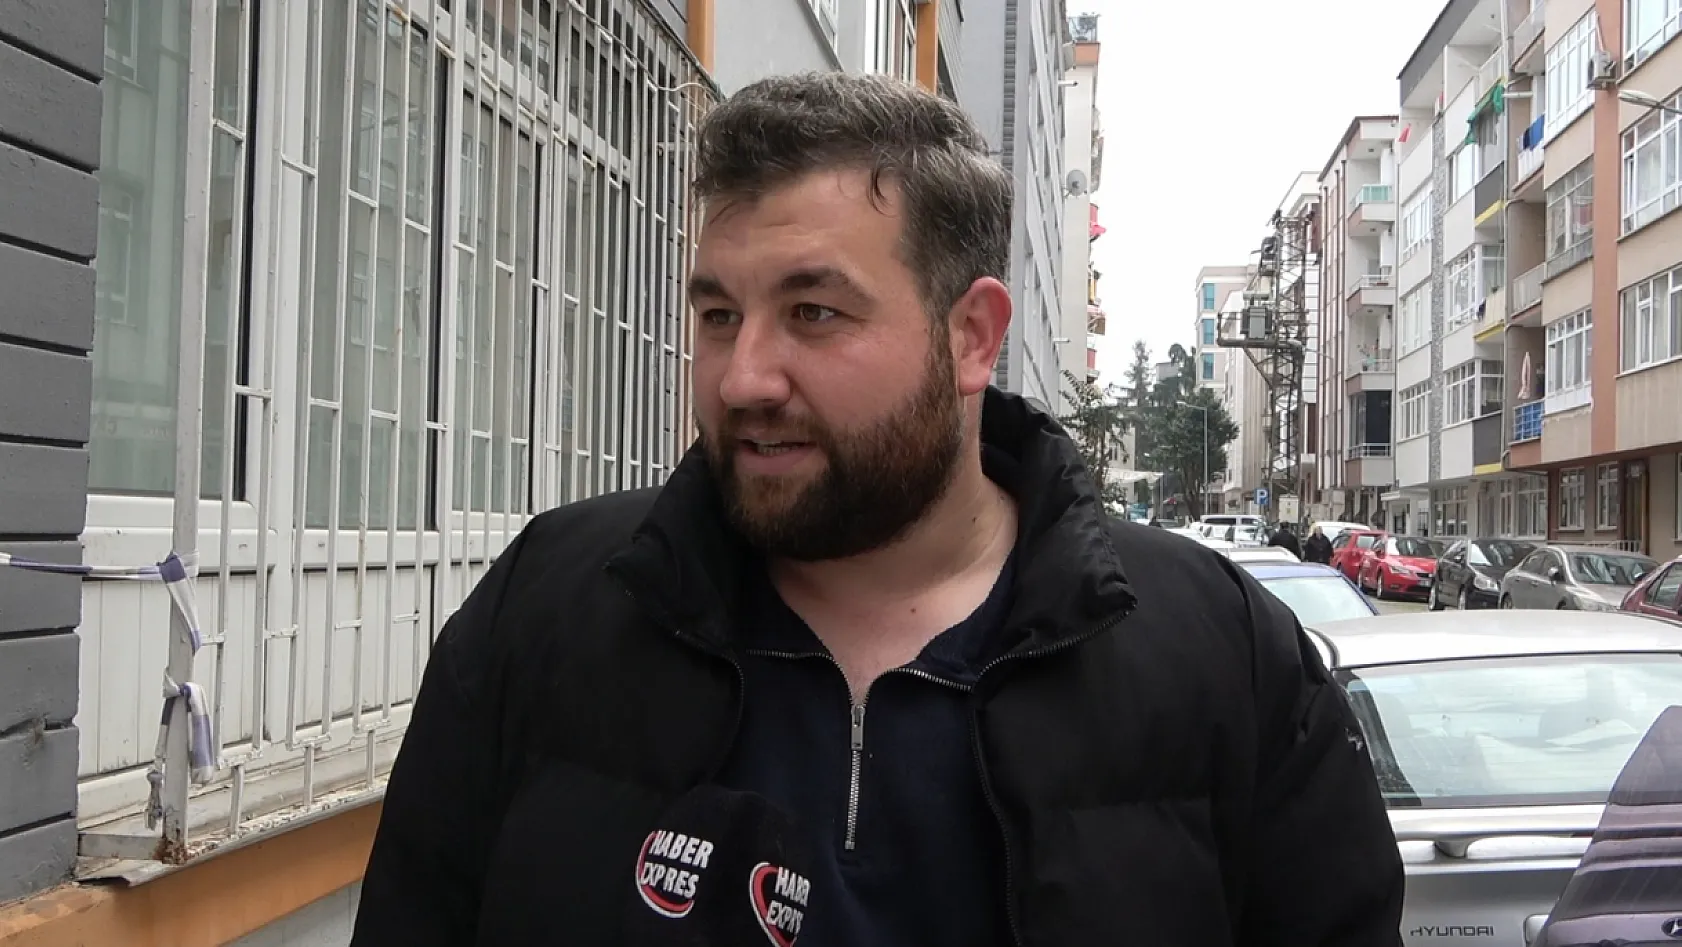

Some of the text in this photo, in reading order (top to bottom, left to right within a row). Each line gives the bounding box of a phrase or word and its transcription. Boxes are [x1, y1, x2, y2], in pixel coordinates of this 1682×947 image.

[649, 830, 714, 868] HABER
[640, 862, 699, 898] EXPRES
[1410, 926, 1494, 936] HYUNDAI
